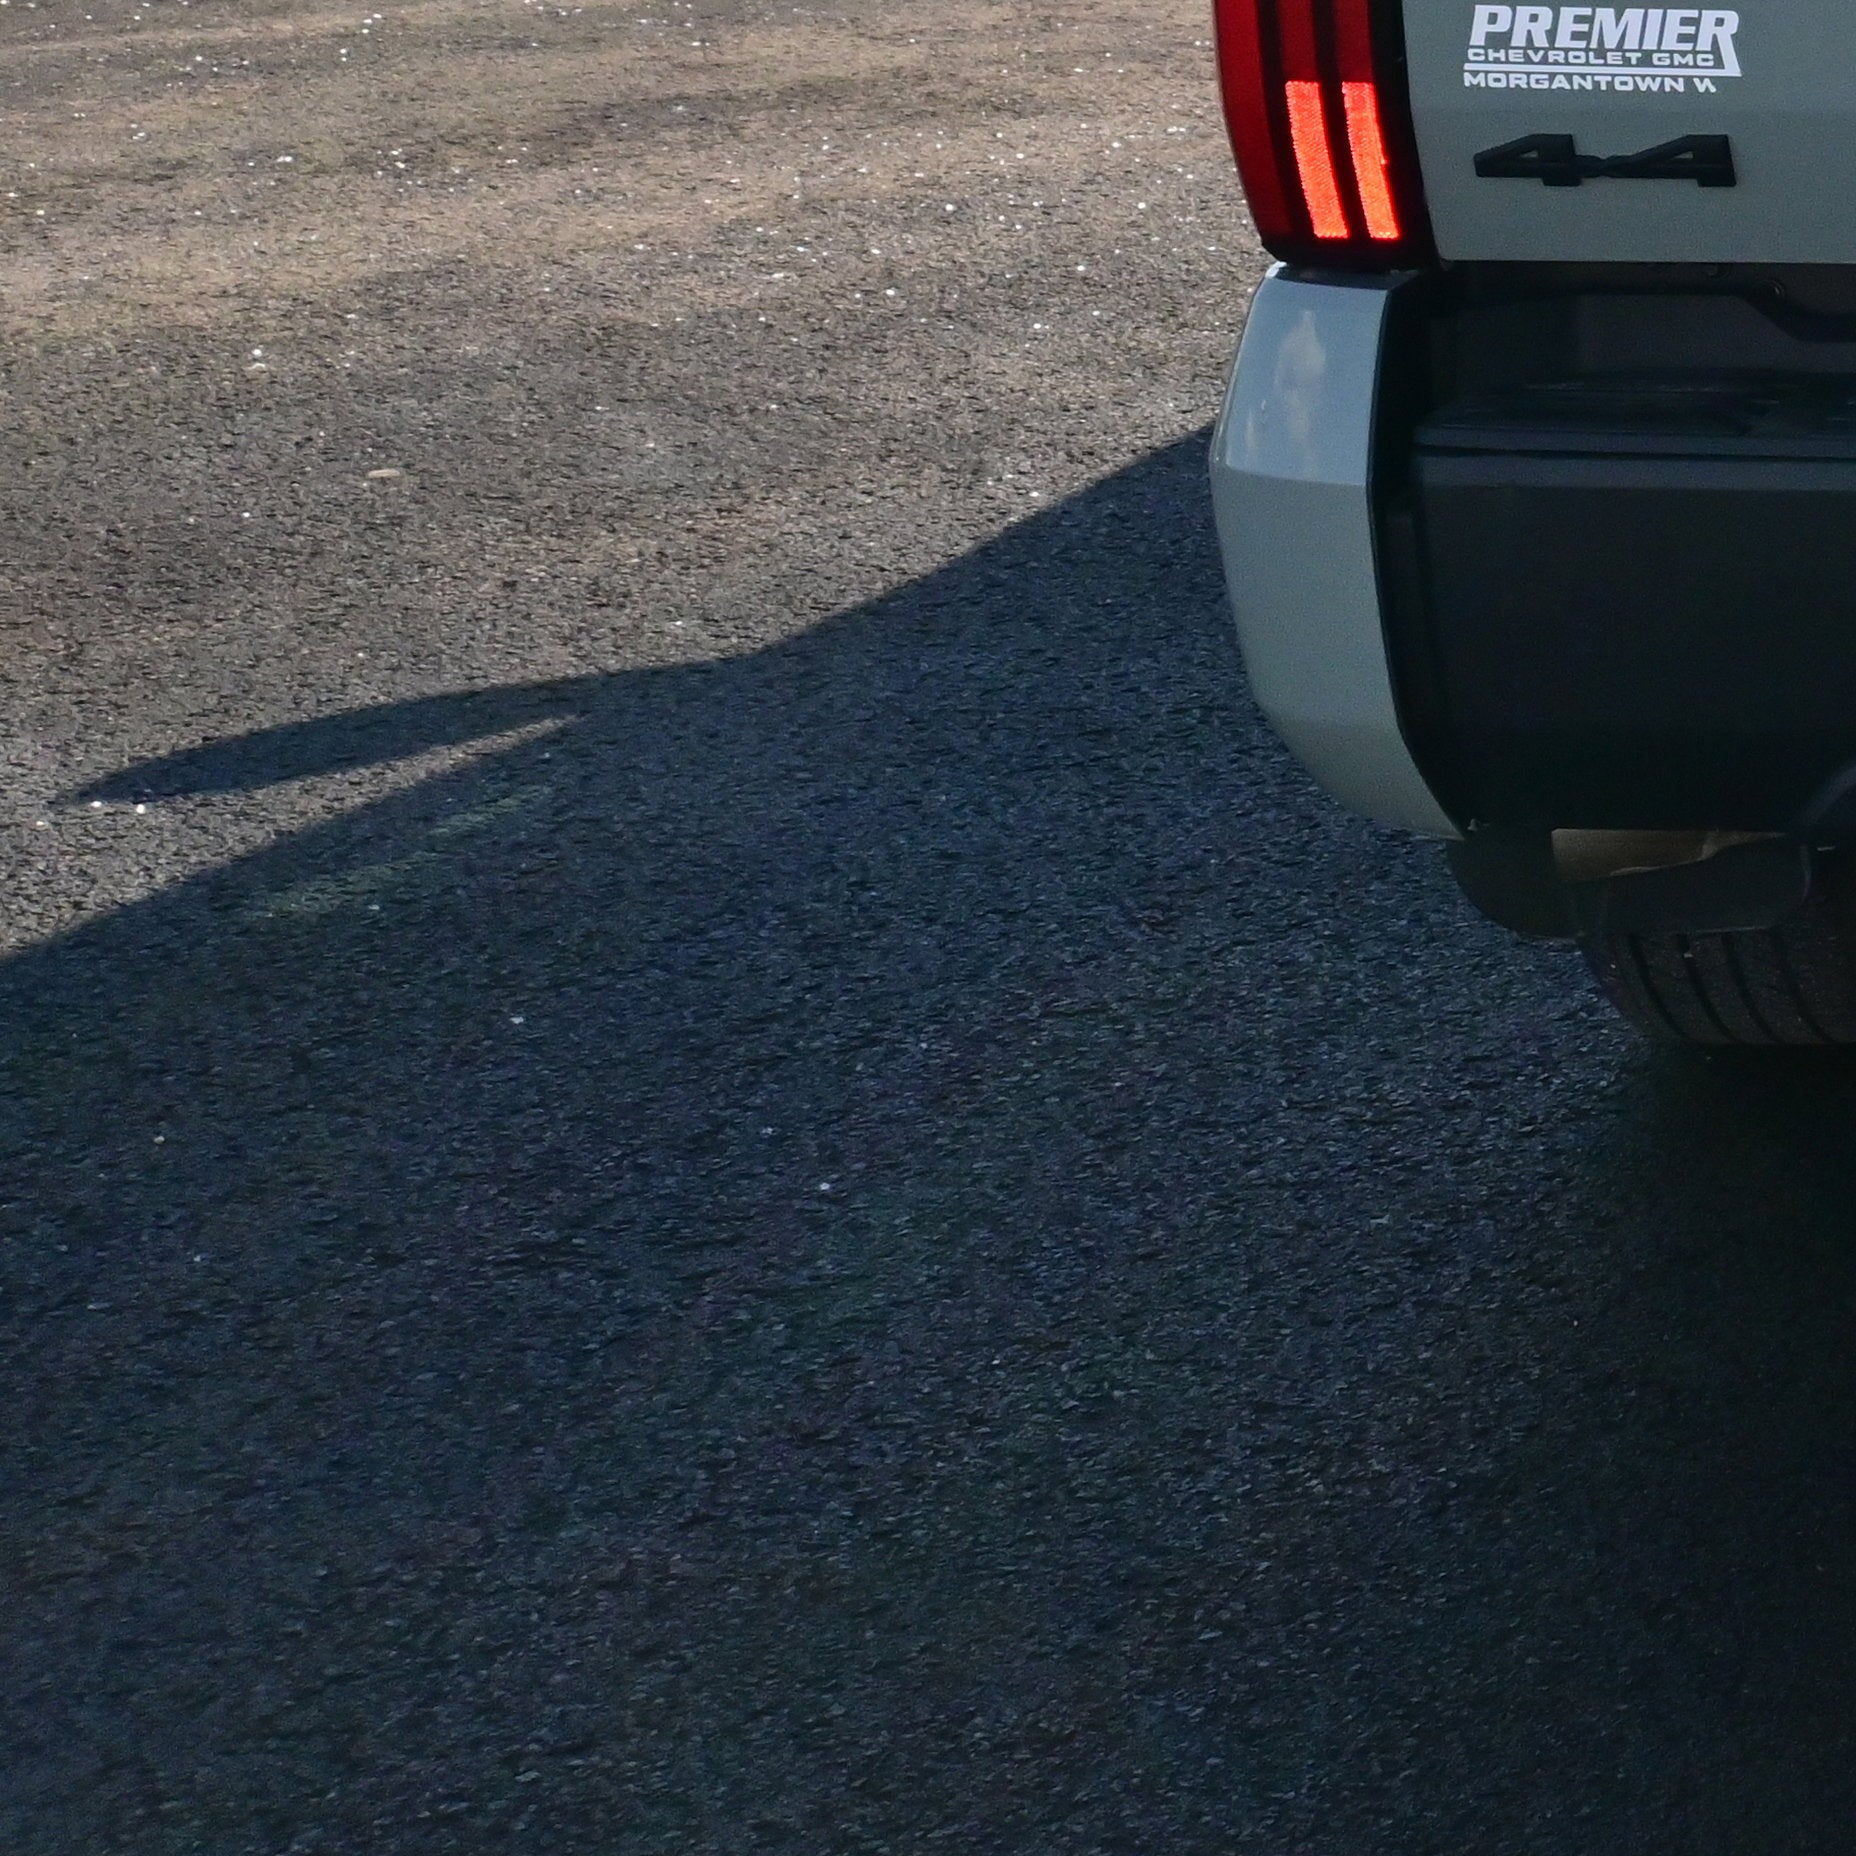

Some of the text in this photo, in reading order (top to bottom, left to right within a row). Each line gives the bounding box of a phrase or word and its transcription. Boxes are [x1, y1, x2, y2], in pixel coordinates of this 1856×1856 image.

[1468, 4, 1742, 56] PREMIER
[1466, 47, 1715, 66] CHEVROLET GMC
[1462, 71, 1685, 93] MORGANTOWN
